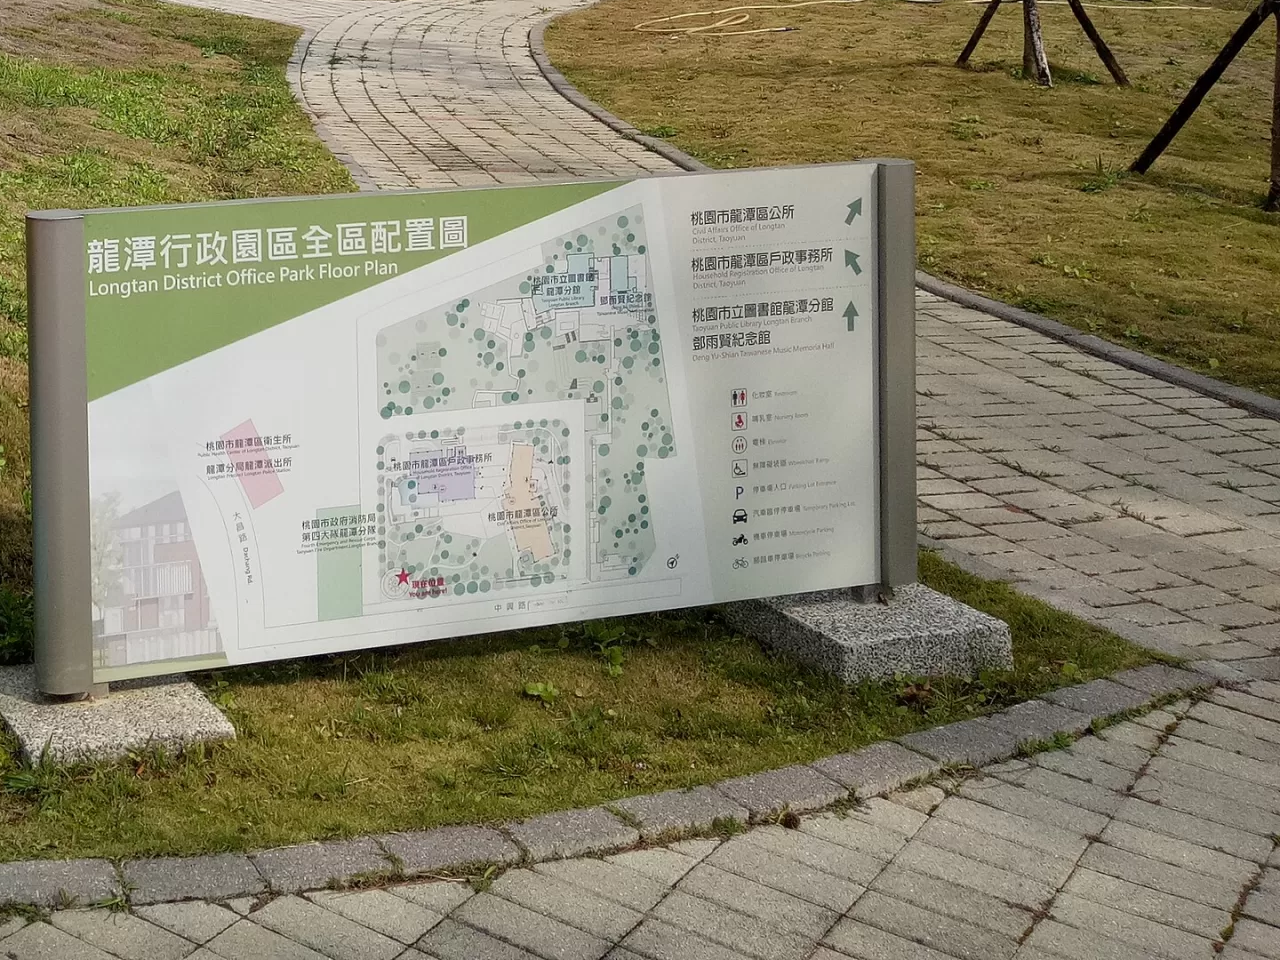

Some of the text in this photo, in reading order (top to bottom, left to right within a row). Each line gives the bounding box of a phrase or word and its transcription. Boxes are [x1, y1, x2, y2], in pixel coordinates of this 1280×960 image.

[691, 204, 795, 226] 桃園市龍潭區公所
[730, 224, 749, 233] Office
[759, 222, 786, 231] Longtan
[86, 215, 468, 275] 龍潭行政園區全區配置圖
[719, 235, 746, 245] Taoyuan
[691, 247, 833, 273] 桃園市龍潭區戶政事務所
[89, 259, 398, 299] Longtan District Office Park Floor Plan
[693, 271, 728, 281] Household
[769, 266, 789, 274] Office
[798, 264, 825, 274] Longtan
[719, 280, 746, 290] Taoyuan
[692, 297, 834, 323] 桃園市立圖書館龍潭分館
[692, 323, 718, 332] Taoyuan
[720, 321, 739, 330] Public
[741, 319, 763, 329] Library
[764, 317, 790, 328] Longtan
[692, 330, 771, 351] 鄧雨賢紀念館
[206, 433, 292, 452] 桃園市龍潭區衛生所
[206, 456, 292, 475] 龍潭分局龍潭派出所
